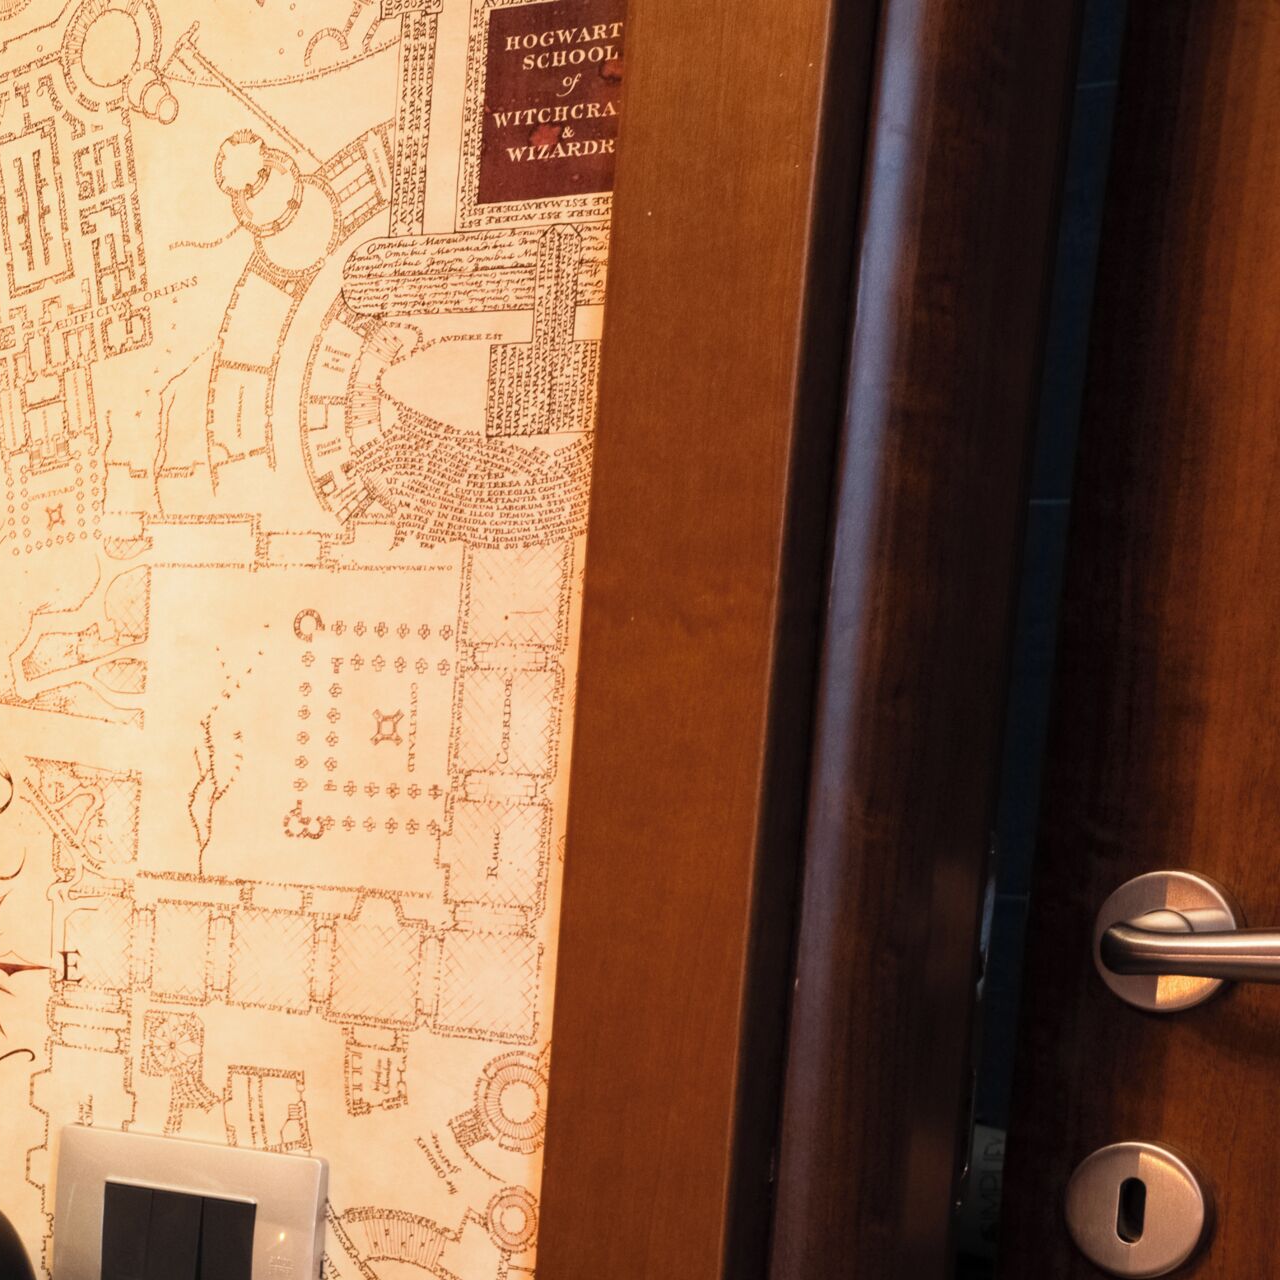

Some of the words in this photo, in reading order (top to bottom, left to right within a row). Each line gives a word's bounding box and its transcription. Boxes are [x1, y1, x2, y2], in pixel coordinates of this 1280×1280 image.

[504, 22, 624, 51] HOGWART
[522, 45, 619, 71] SCHOOL
[556, 73, 582, 97] of
[493, 102, 618, 129] WITCHCRA
[561, 126, 575, 138] &
[506, 139, 615, 162] WIZARDR
[143, 275, 198, 302] ORIENS
[57, 950, 85, 984] E
